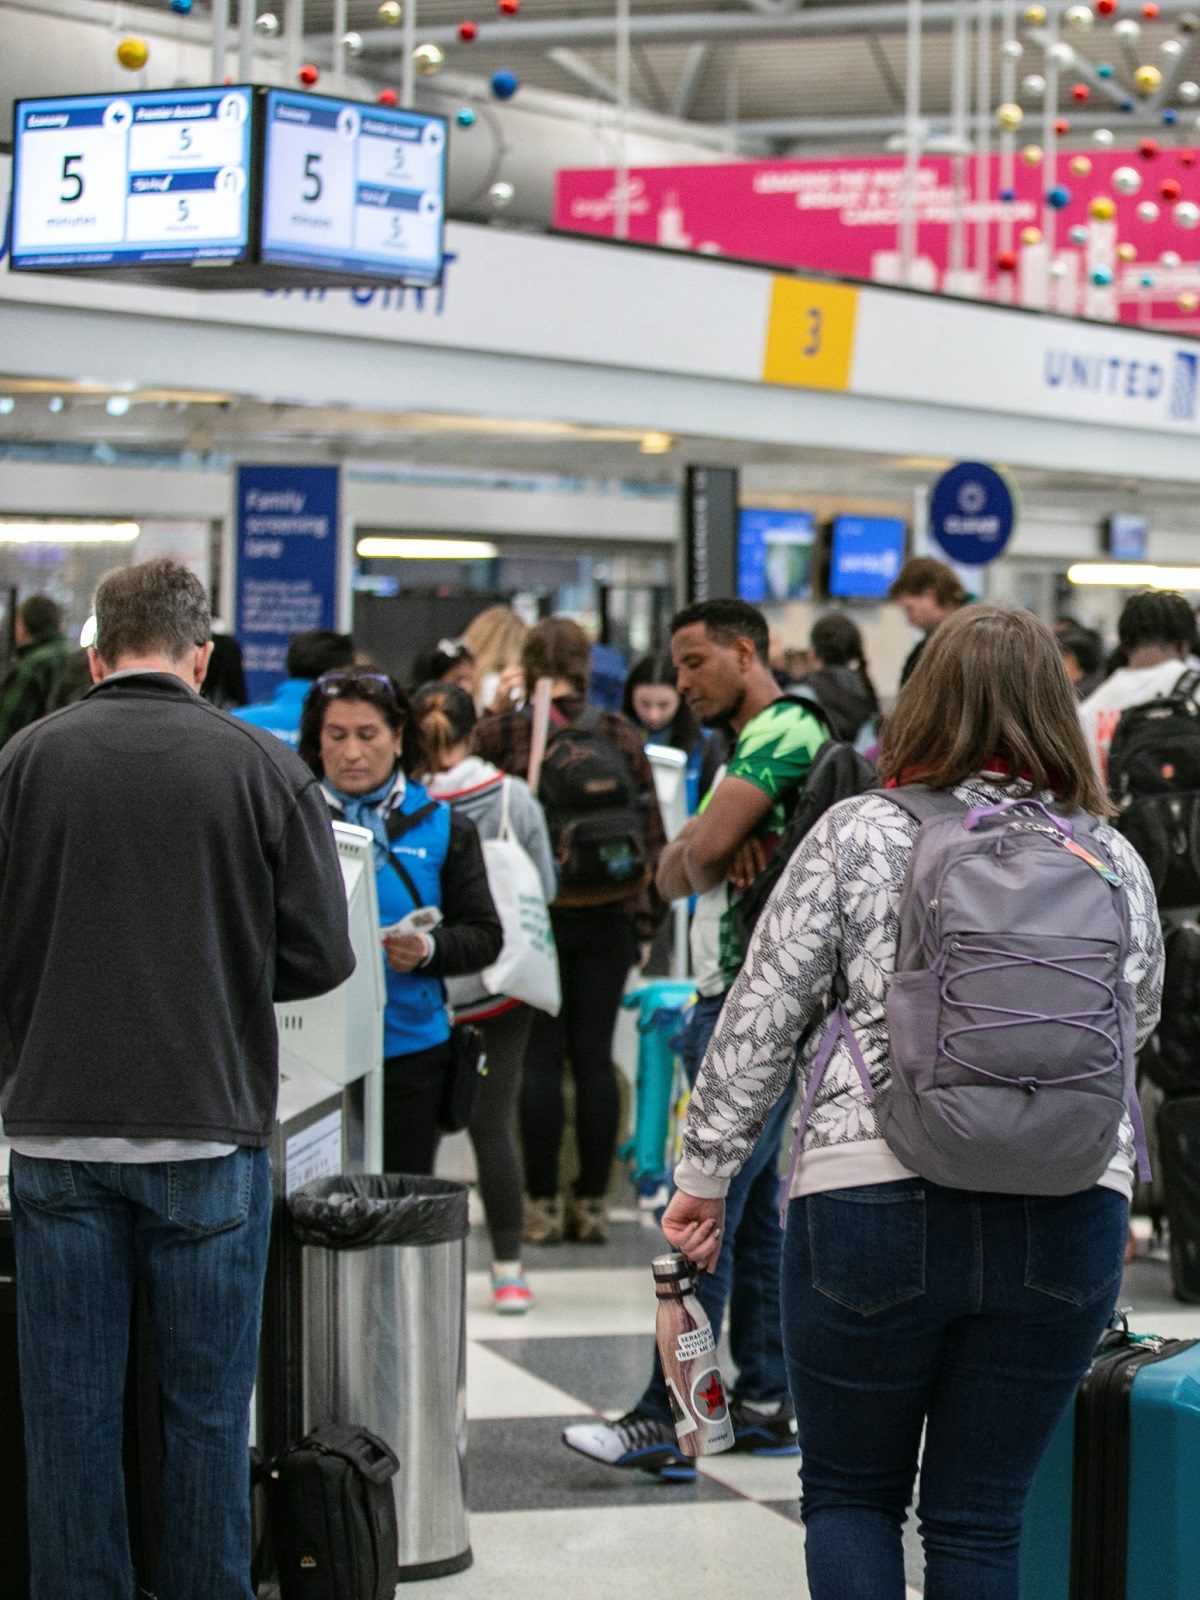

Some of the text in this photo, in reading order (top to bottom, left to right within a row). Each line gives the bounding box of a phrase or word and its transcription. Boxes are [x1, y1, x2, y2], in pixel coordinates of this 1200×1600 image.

[178, 127, 193, 150] 5
[60, 154, 84, 202] 5
[304, 153, 323, 202] 5
[176, 199, 190, 222] 5
[803, 307, 824, 357] 3
[1044, 350, 1163, 398] UNITED
